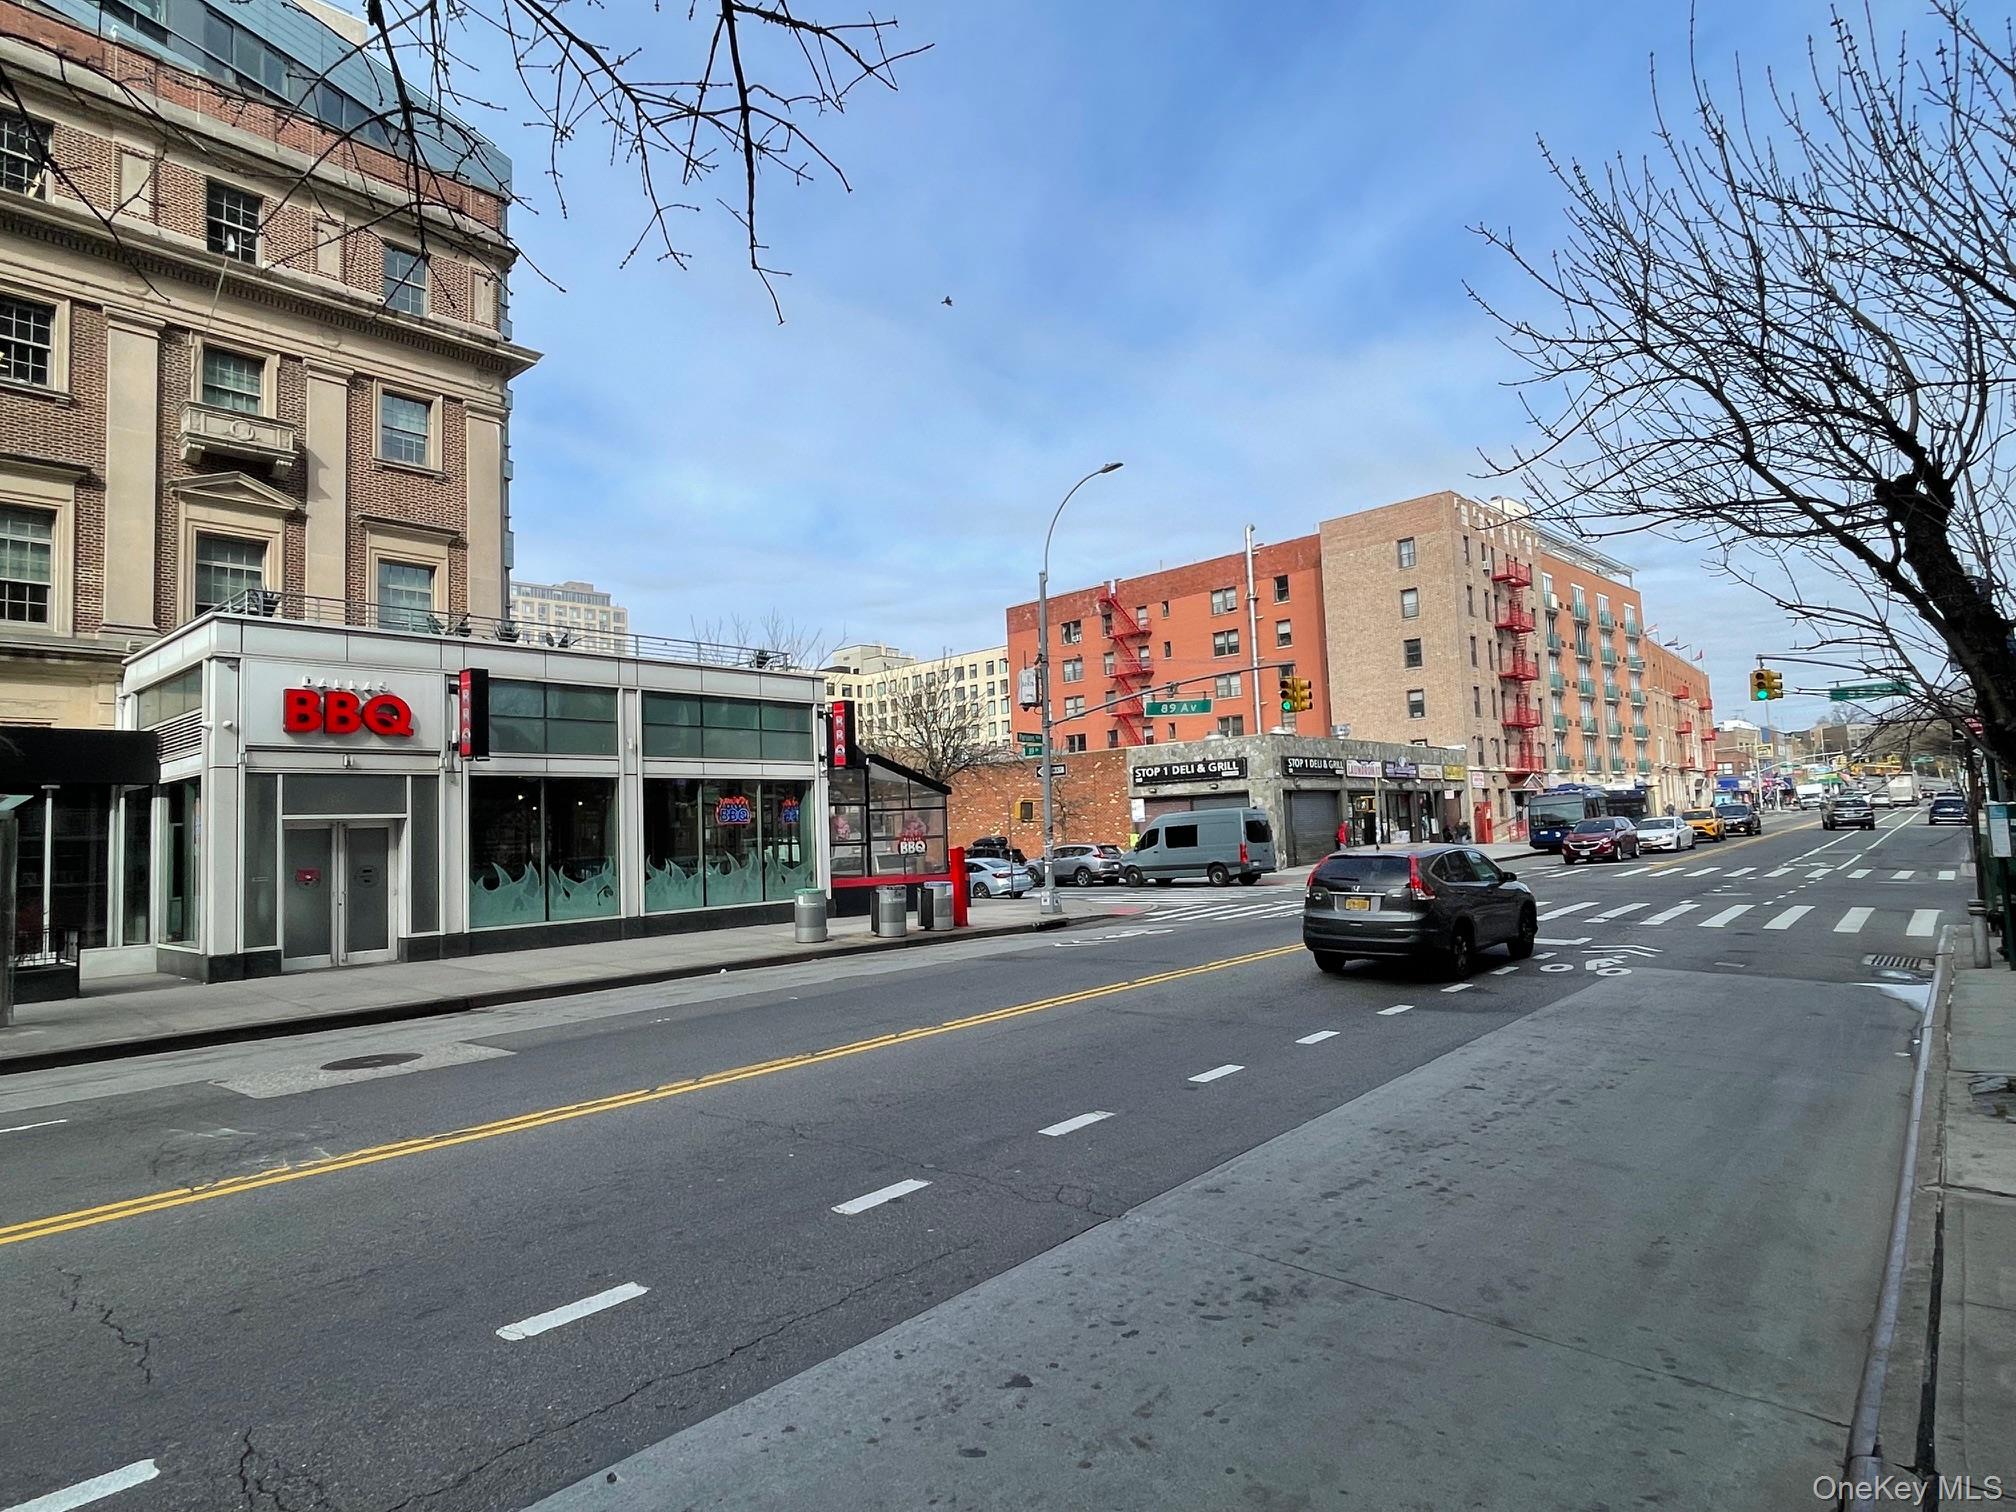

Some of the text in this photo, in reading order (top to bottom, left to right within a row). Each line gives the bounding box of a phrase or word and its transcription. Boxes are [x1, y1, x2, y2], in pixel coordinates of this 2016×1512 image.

[301, 675, 389, 692] DALLAS
[283, 688, 414, 737] BBQ
[462, 688, 471, 743] BBQ
[1161, 702, 1197, 714] 89 Av
[835, 715, 846, 756] BBQ
[1135, 761, 1239, 778] STOP 1 DELI & GRILL
[1288, 758, 1304, 768] STOP
[1309, 759, 1322, 769] DELI
[1322, 760, 1328, 769] &
[1328, 760, 1344, 769] GRILL
[719, 808, 749, 822] BBQ
[900, 840, 926, 855] BBQ
